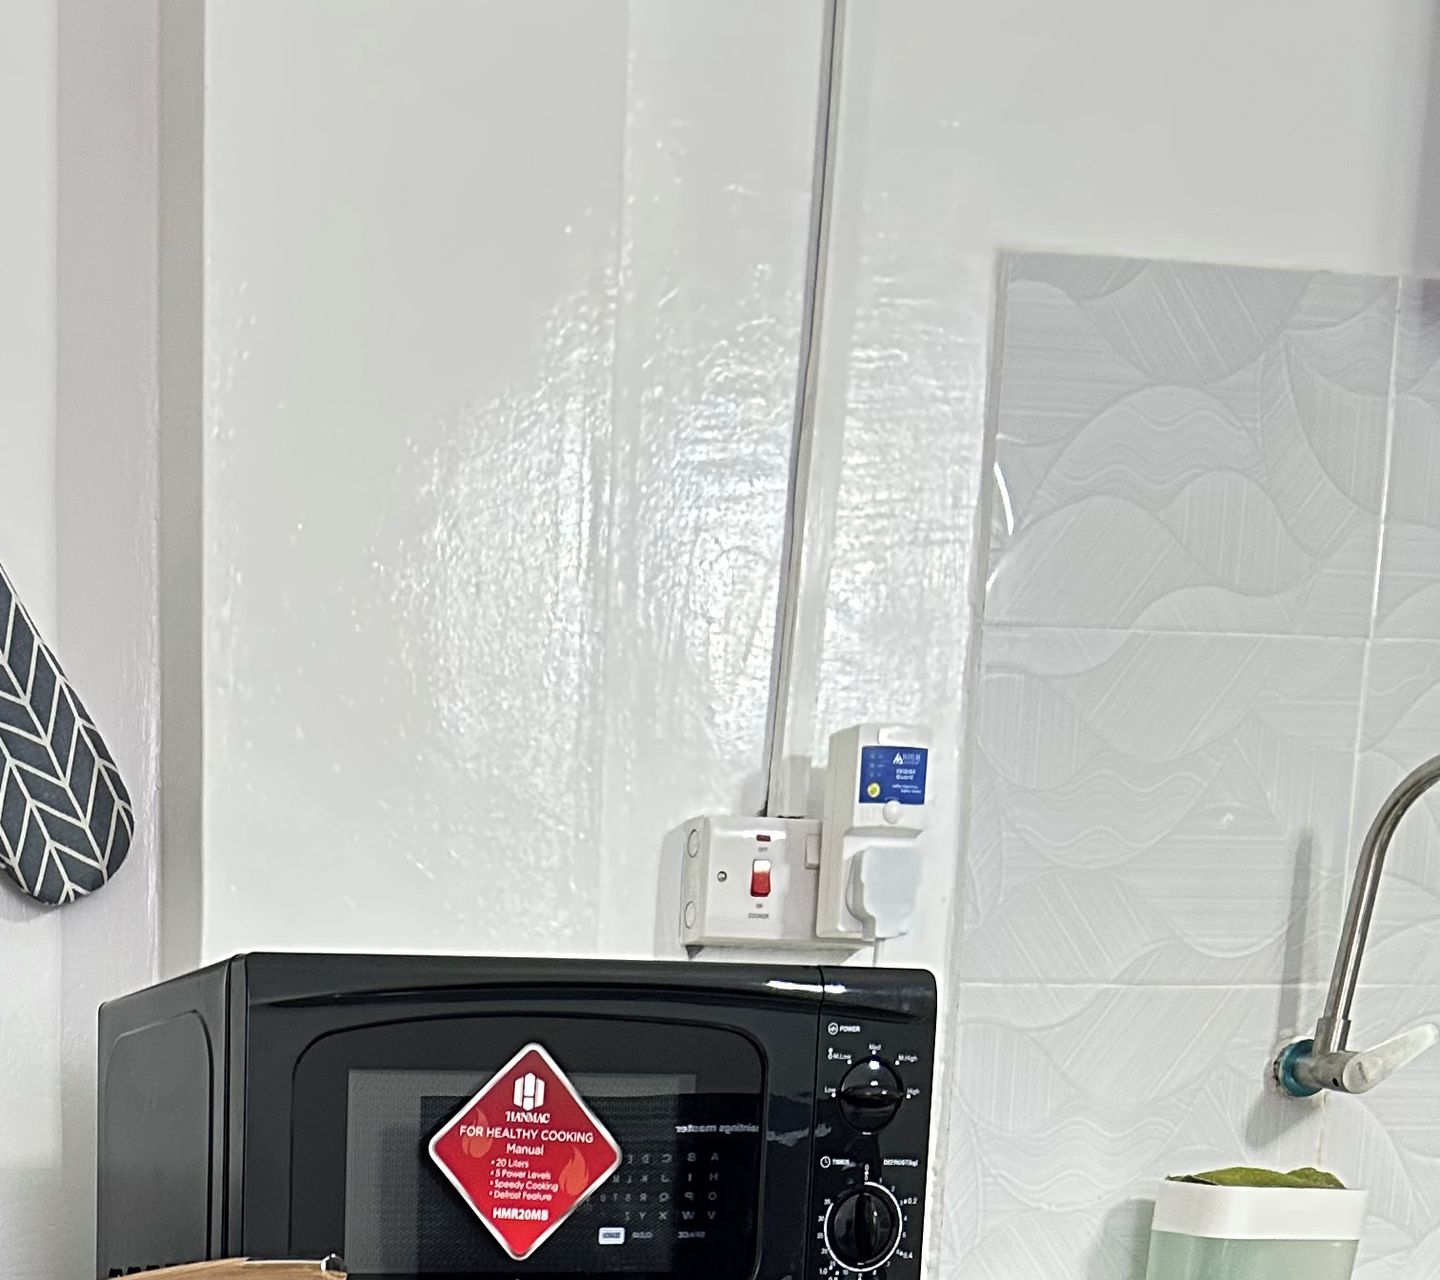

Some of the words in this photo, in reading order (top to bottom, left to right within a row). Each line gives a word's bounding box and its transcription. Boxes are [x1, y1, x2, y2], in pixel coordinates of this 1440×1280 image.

[460, 1125, 483, 1137] FOR
[486, 1127, 538, 1139] HEALTHY
[541, 1130, 593, 1143] COOKING
[506, 1143, 544, 1155] Manual
[496, 1159, 506, 1167] 20
[508, 1159, 529, 1168] Liters
[501, 1169, 526, 1179] Power
[528, 1170, 551, 1180] Levels
[494, 1180, 524, 1190] Speedy
[526, 1180, 559, 1192] Cooking
[494, 1190, 521, 1199] Defrost
[522, 1192, 552, 1201] Feature
[493, 1207, 549, 1220] HMR20MB
